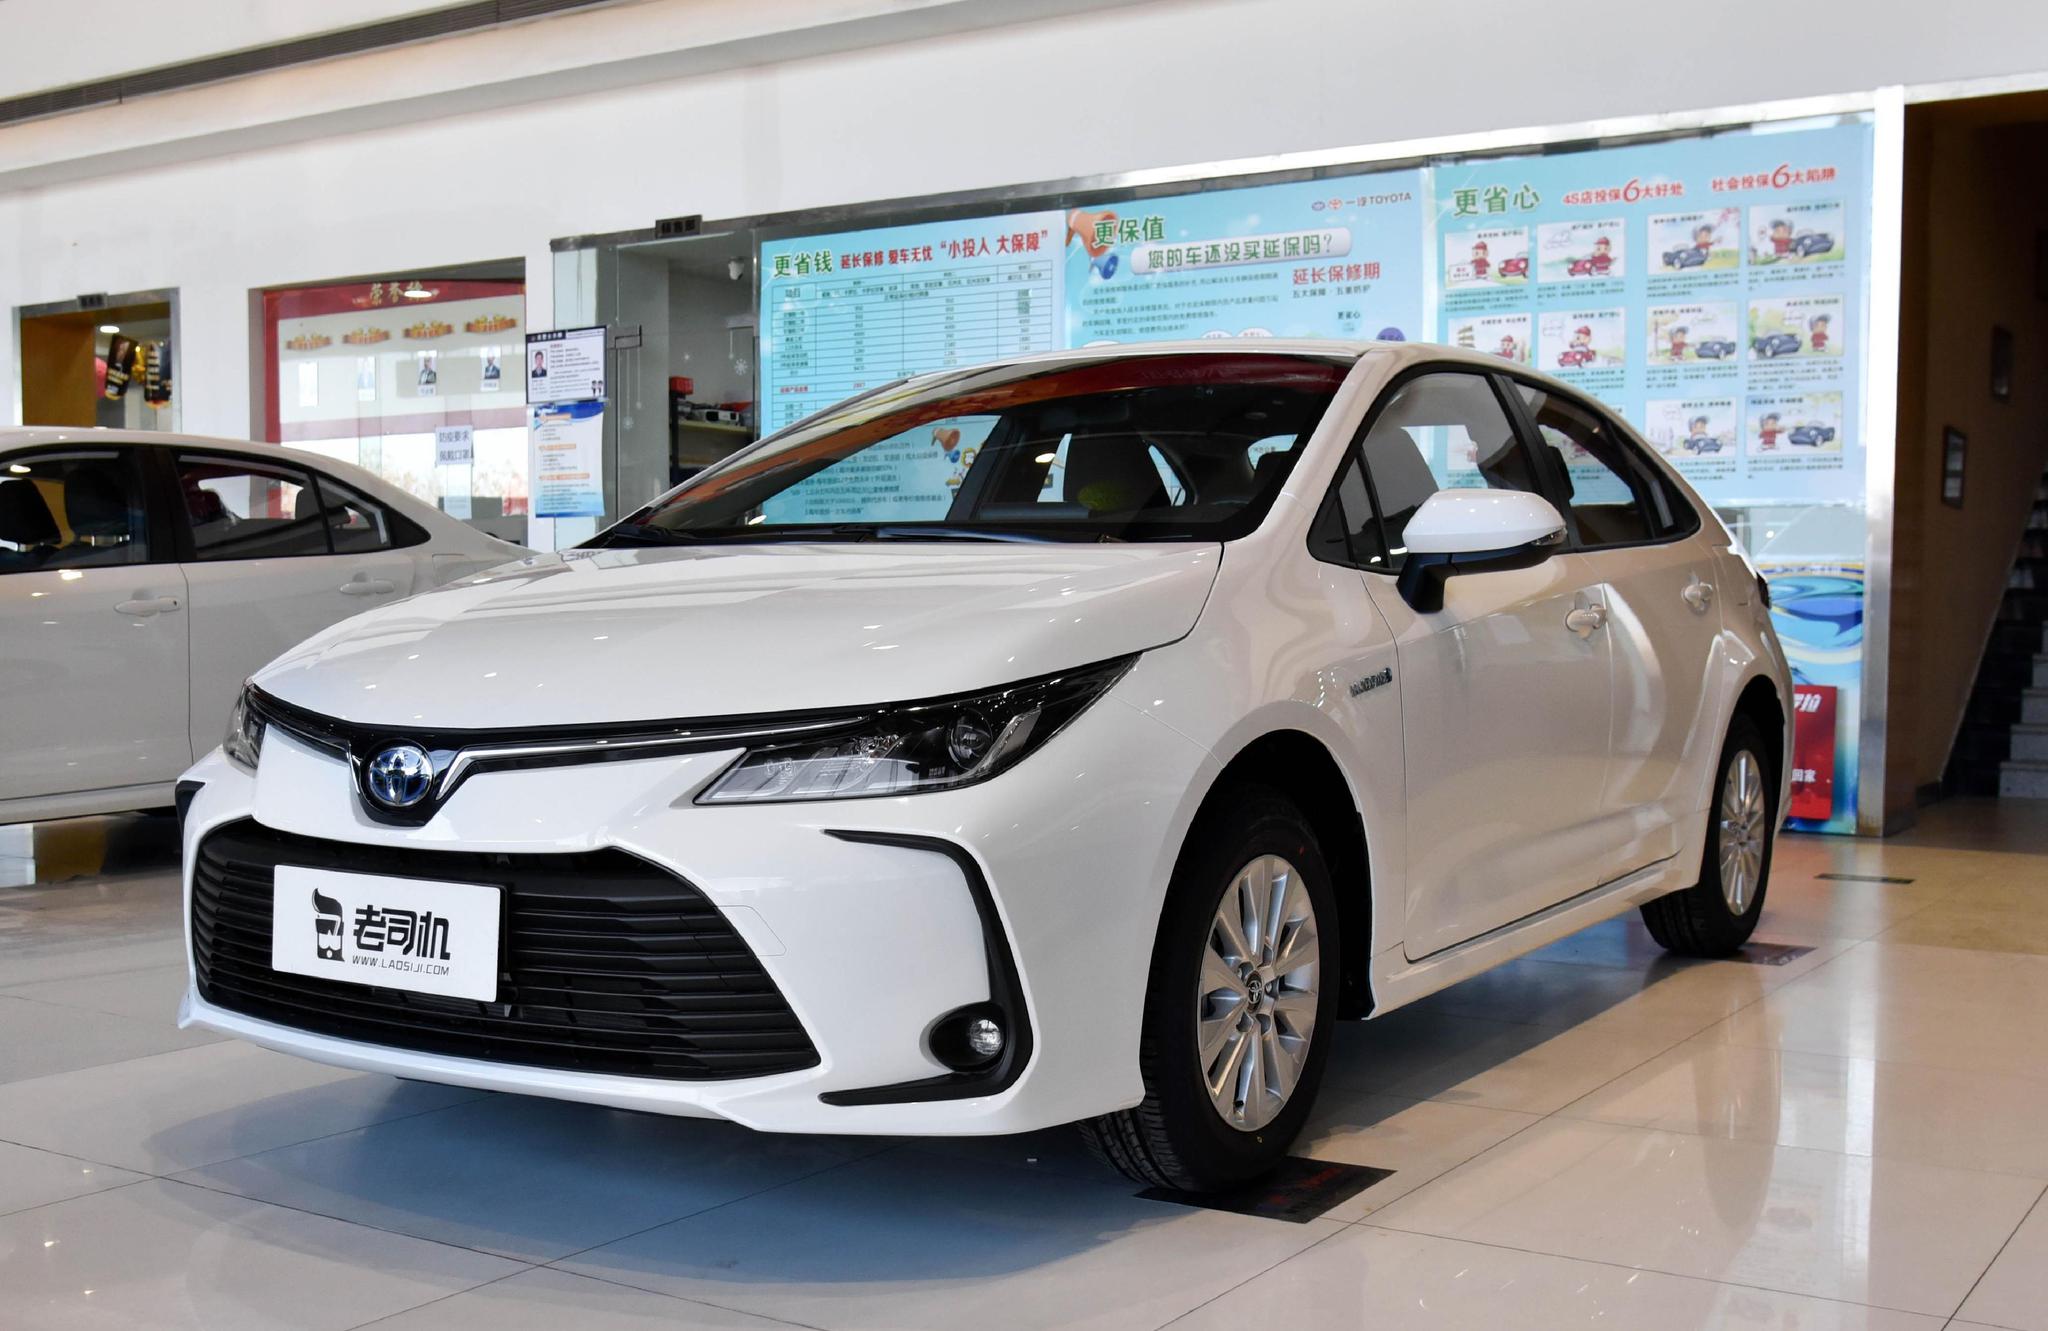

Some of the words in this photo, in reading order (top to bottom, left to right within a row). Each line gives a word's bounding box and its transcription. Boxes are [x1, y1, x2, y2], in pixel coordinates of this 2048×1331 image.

[1453, 184, 1540, 216] 更省心
[1093, 216, 1164, 246] 更保值
[774, 250, 833, 277] 更省钱
[1148, 234, 1333, 269] 您的车还没买延保吗?
[1293, 262, 1380, 285] 延长保修期
[353, 904, 451, 961] 老司机
[352, 955, 450, 976] WWW.LAOSIJI.COM
